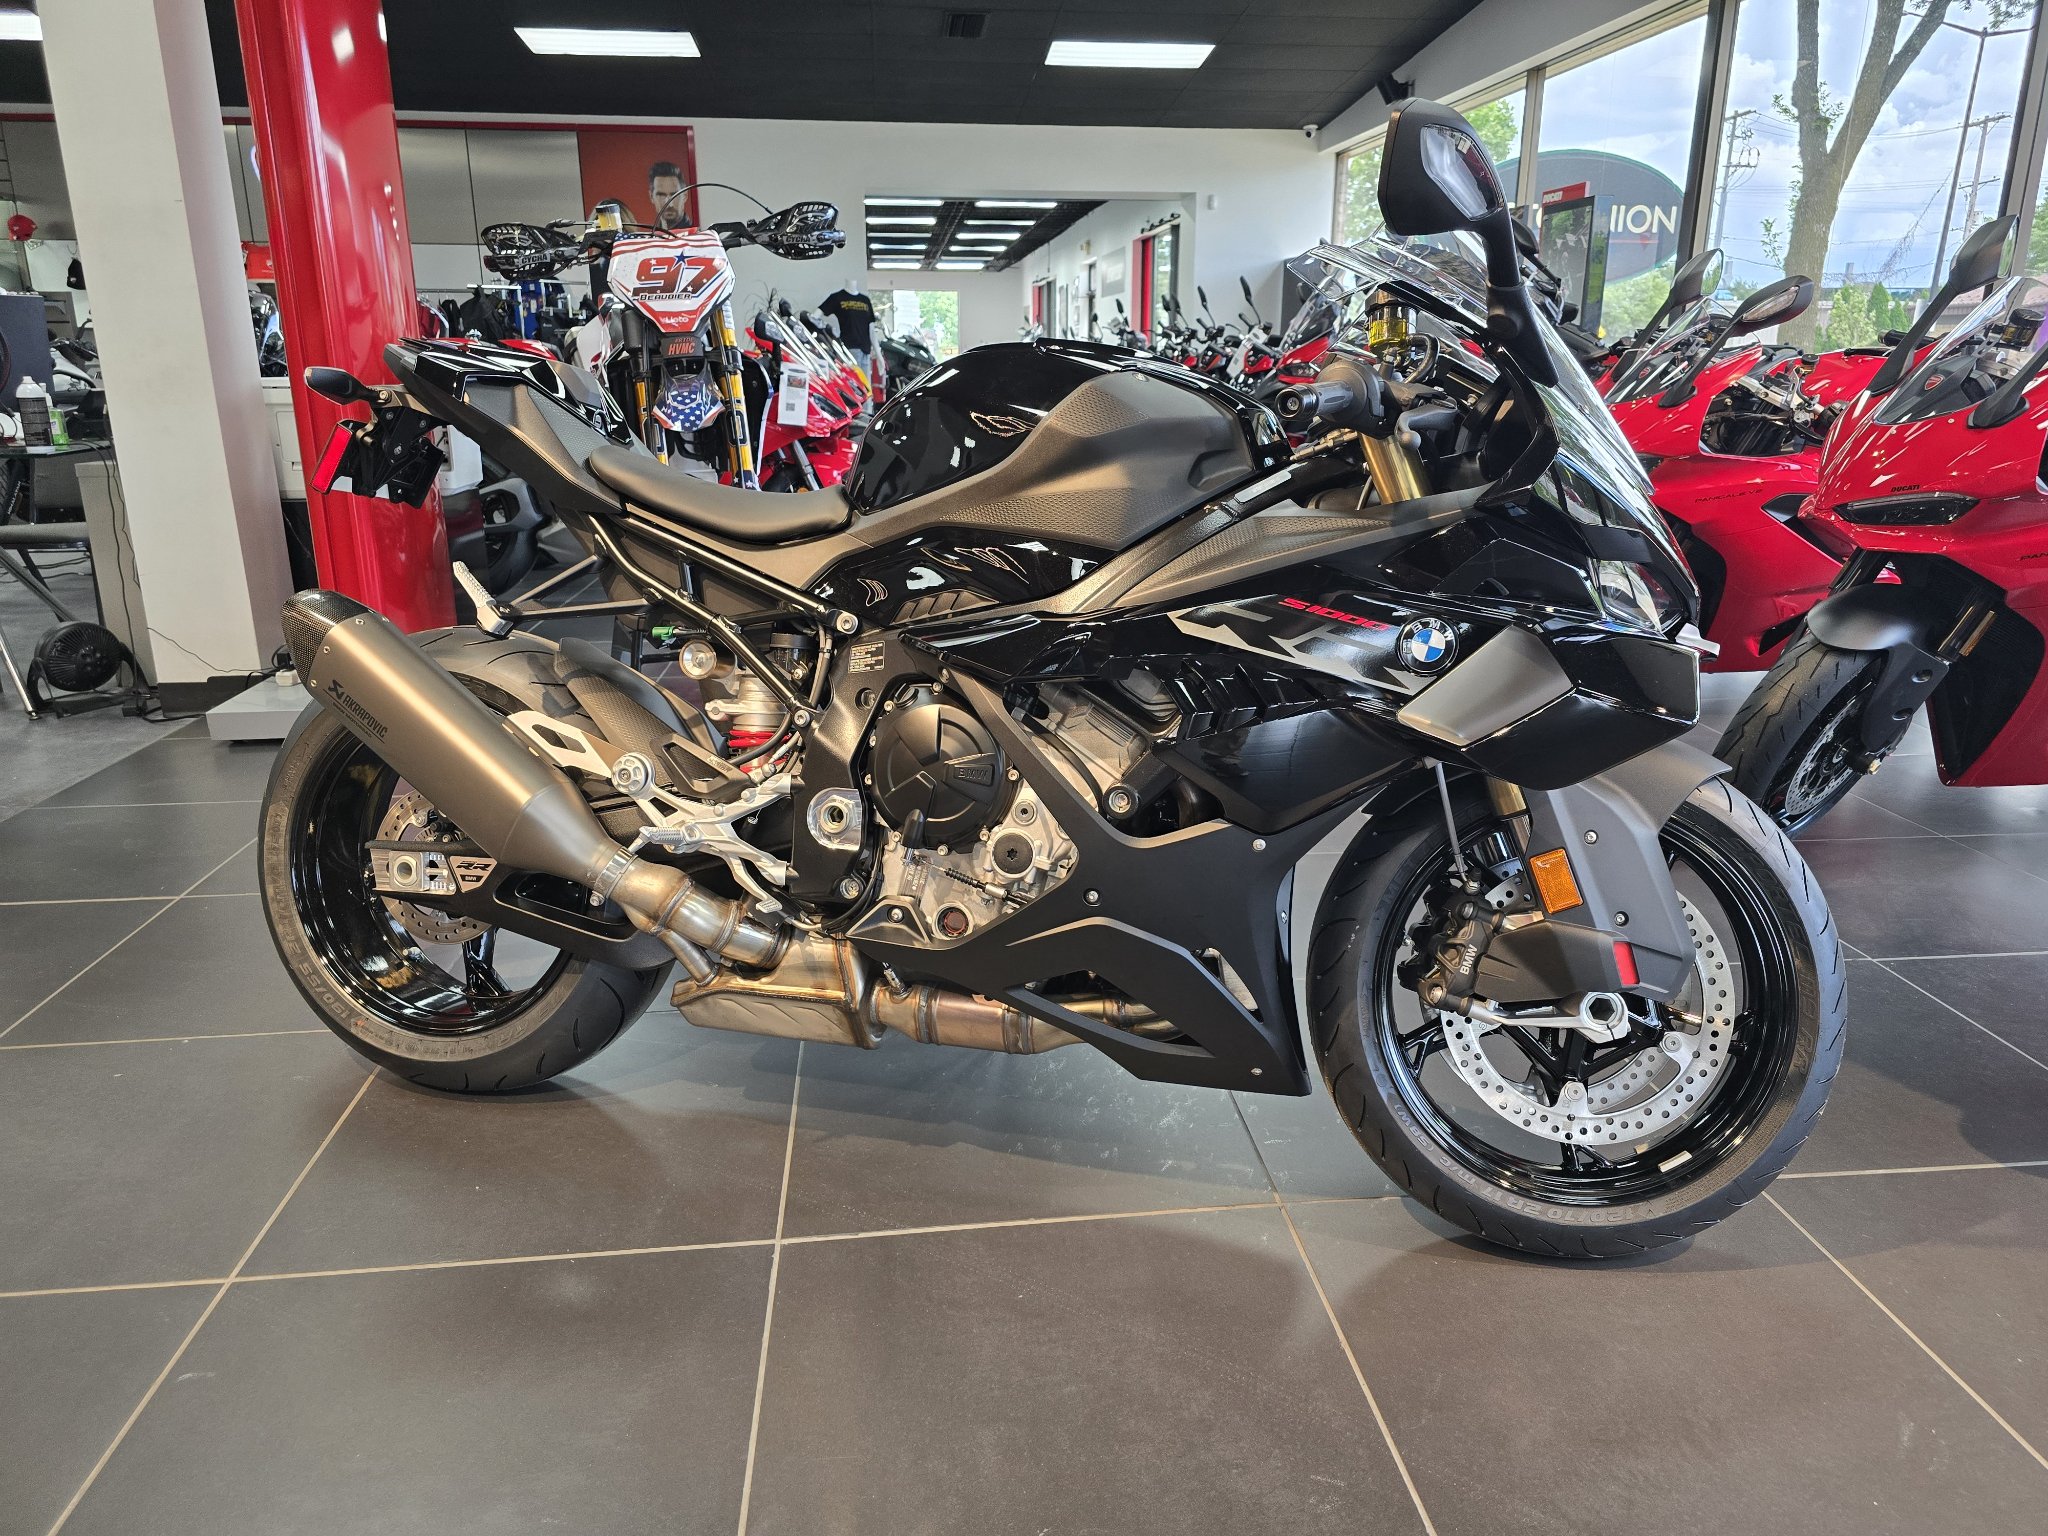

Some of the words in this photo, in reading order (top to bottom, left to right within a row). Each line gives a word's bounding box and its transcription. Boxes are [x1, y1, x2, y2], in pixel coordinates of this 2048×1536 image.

[632, 257, 727, 294] 97
[668, 342, 695, 356] HVMC
[1891, 484, 1920, 493] DUCATI
[1279, 597, 1388, 631] S1000
[1410, 618, 1454, 641] BMW
[957, 767, 989, 780] BMW
[1459, 943, 1478, 976] BMW
[298, 962, 351, 1020] 190/55
[1394, 1103, 1436, 1153] (58W)
